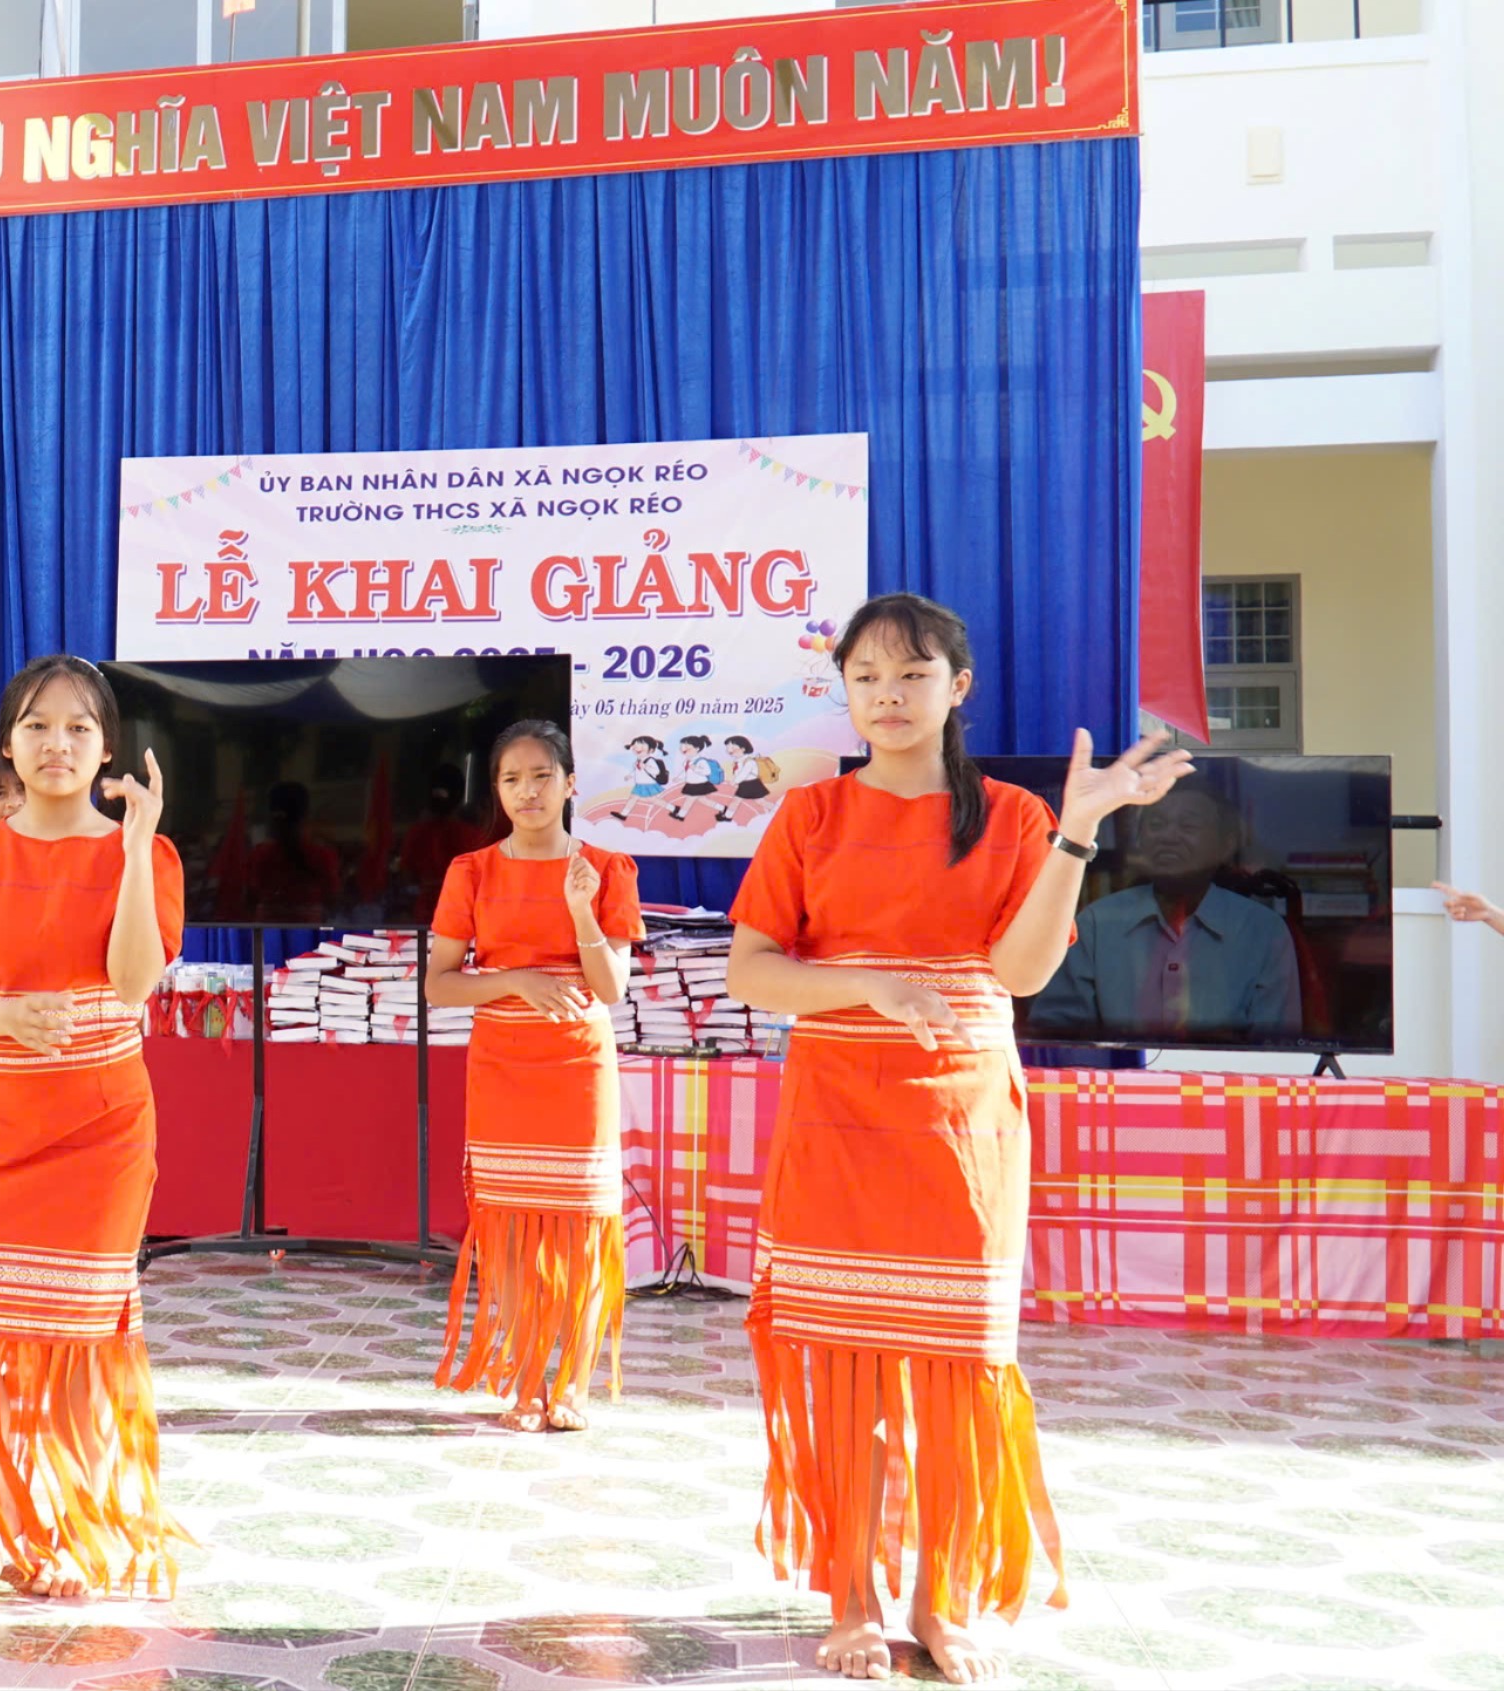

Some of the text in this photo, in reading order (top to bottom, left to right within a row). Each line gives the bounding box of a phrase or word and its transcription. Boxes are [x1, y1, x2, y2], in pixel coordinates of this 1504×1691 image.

[23, 94, 227, 183] NGHĨA
[246, 80, 391, 176] VIỆT
[413, 75, 578, 154] NAM
[603, 45, 829, 140] MUÔN
[854, 28, 1066, 122] NĂM!
[259, 462, 709, 493] ỦY BAN NHÂN DÂN XÃ NGỌK RÉO
[296, 491, 683, 523] TRƯỜNG THCS XÃ NGỌK RÉO
[154, 527, 817, 625] LỄ KHAI GIẢNG
[602, 644, 714, 681] 2026
[570, 696, 785, 720] ày 05 tháng 09 năm 2025
